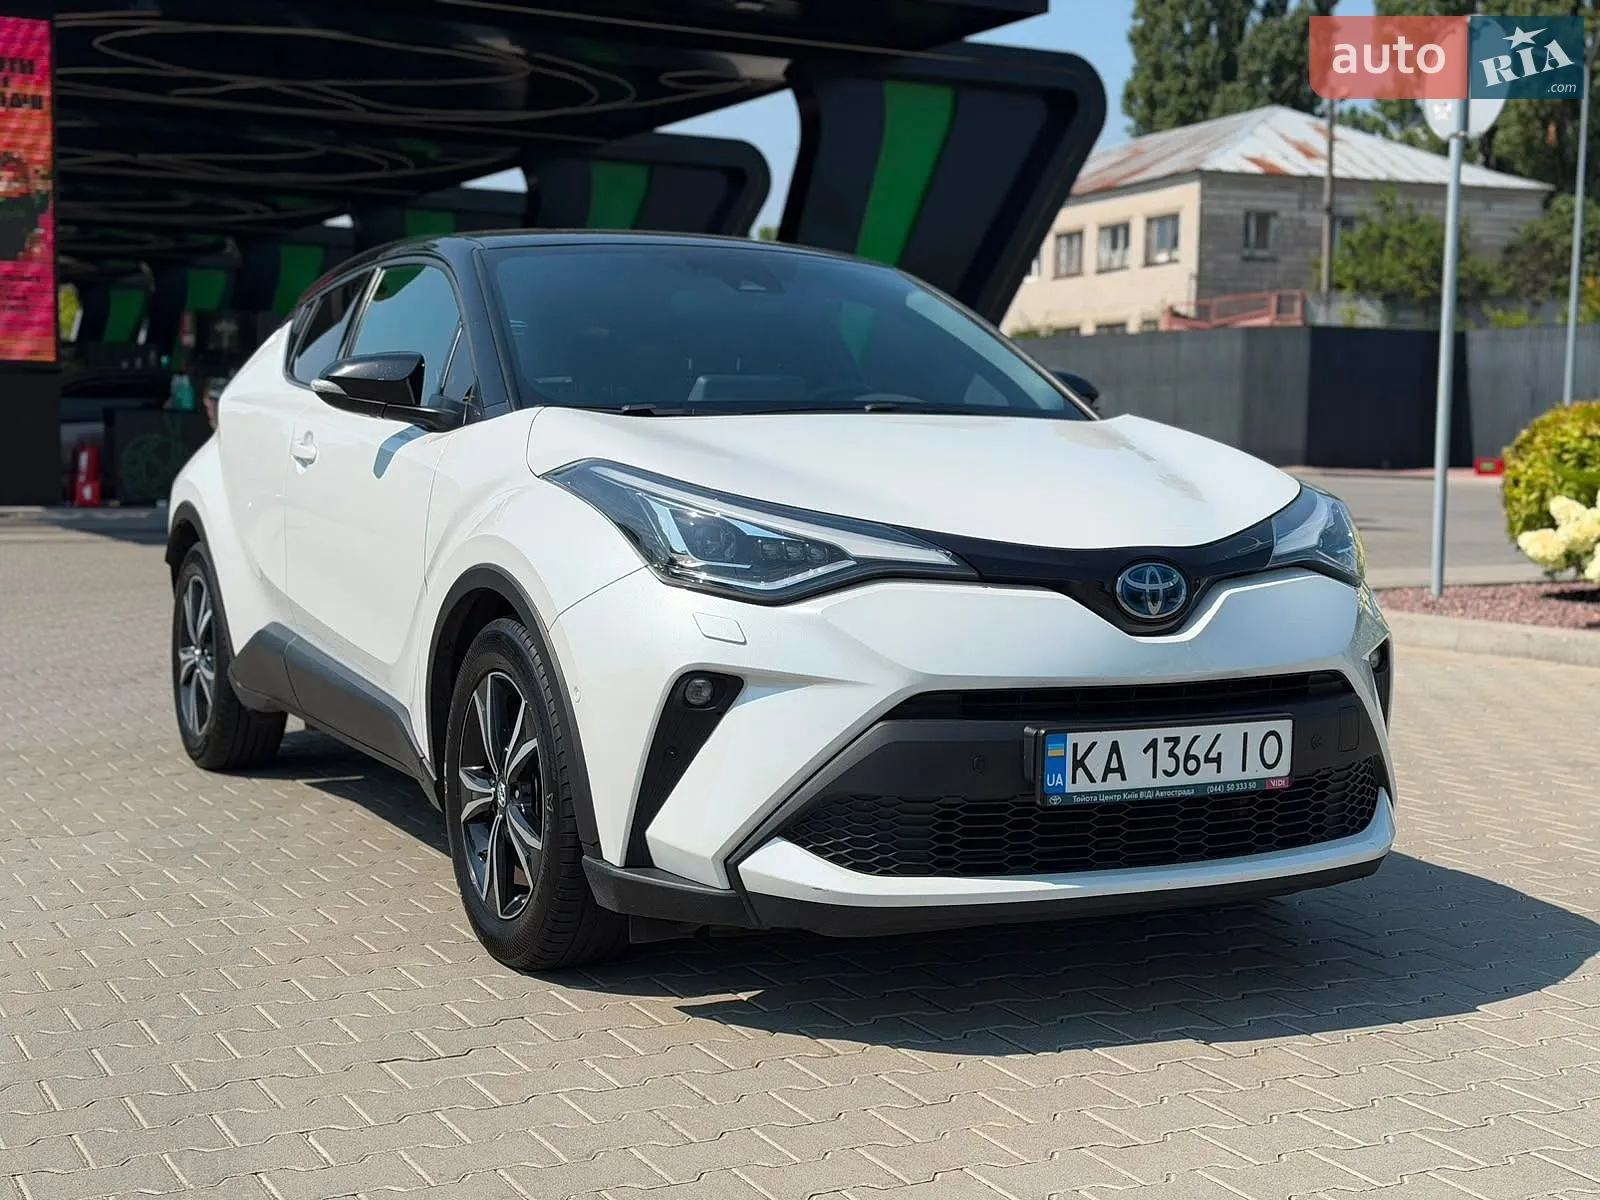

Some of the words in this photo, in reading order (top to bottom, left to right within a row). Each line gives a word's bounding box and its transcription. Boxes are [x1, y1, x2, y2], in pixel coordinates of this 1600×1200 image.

[1071, 740, 1127, 784] KA
[1142, 733, 1222, 779] 1364
[1241, 730, 1283, 772] IO
[1046, 773, 1063, 786] UA
[1072, 793, 1098, 803] Тойота
[1099, 792, 1121, 802] Центр
[1122, 790, 1138, 800] Київ
[1139, 789, 1154, 799] ВІДІ
[1155, 788, 1195, 799] Автострада
[1206, 785, 1224, 794] (044)
